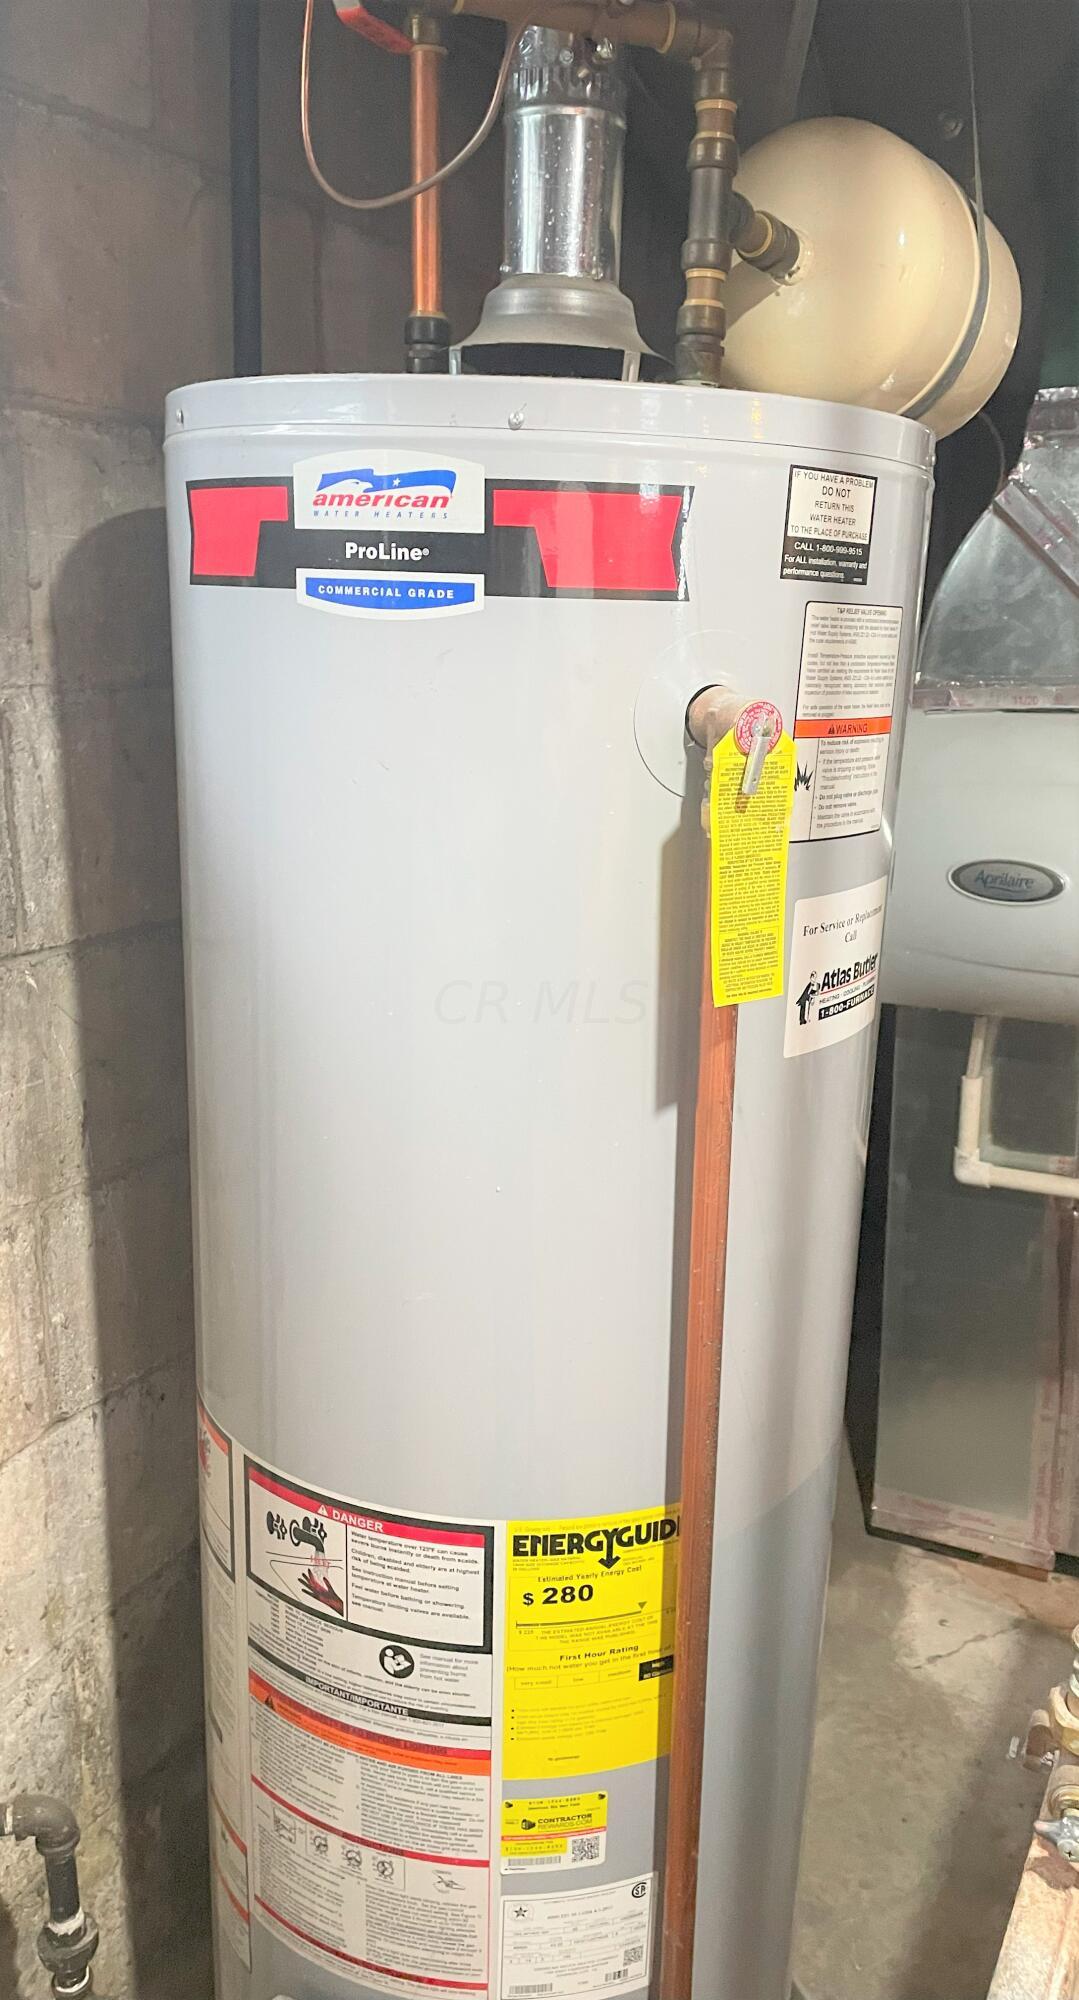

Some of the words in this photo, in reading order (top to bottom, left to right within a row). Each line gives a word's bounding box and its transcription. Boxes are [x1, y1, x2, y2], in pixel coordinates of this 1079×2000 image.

[804, 472, 818, 480] YOU
[820, 474, 839, 483] HAVE
[846, 477, 873, 488] PROBLEM
[822, 486, 833, 495] DO
[836, 488, 851, 498] NOT
[313, 493, 449, 509] american
[815, 501, 840, 510] RETURN
[842, 504, 855, 512] THIS
[374, 511, 448, 519] HEATERS
[810, 513, 832, 523] WATER
[834, 517, 856, 526] HEATER
[791, 525, 799, 533] TO
[801, 526, 812, 535] THE
[814, 527, 832, 537] PLACE
[834, 529, 841, 537] OF
[842, 530, 868, 541] PURCHASE
[794, 541, 814, 551] CALL
[817, 544, 863, 556] 1-800-999-9515
[784, 554, 795, 562] For
[796, 555, 807, 564] ALL
[783, 567, 819, 576] performance
[318, 585, 402, 597] COMMERCIAL
[408, 588, 454, 599] GRADE
[836, 724, 868, 734] WARNING
[975, 870, 1034, 889] Aprilaire
[803, 925, 818, 936] For
[820, 920, 845, 933] Service
[847, 918, 853, 926] or
[845, 930, 857, 942] Call
[821, 968, 851, 991] Atlas
[853, 953, 878, 980] Butler
[332, 1509, 384, 1533] DANGER
[351, 1531, 367, 1540] Water
[368, 1536, 402, 1548] temperature
[351, 1538, 369, 1547] severe
[370, 1542, 387, 1551] burns
[370, 1559, 386, 1569] being
[377, 1555, 402, 1565] disabled
[416, 1562, 436, 1571] elderly
[456, 1567, 480, 1576] highest
[351, 1573, 384, 1586] temperature
[363, 1569, 393, 1580] instruction
[394, 1576, 416, 1585] manual
[417, 1580, 437, 1588] before
[438, 1583, 460, 1591] setting
[538, 1575, 573, 1583] Estimated
[576, 1572, 598, 1581] Yearly
[601, 1569, 625, 1577] Energy
[627, 1565, 642, 1573] Cost
[351, 1593, 386, 1606] Temperature
[380, 1590, 399, 1599] before
[400, 1594, 423, 1604] bathing
[523, 1593, 534, 1606] $
[542, 1584, 594, 1605] 280
[559, 1654, 581, 1662] First
[609, 1645, 639, 1655] Rating
[305, 1676, 409, 1716] IMPORTANT/IMPORTANTE
[538, 1813, 592, 1824] CONTRACTOR
[538, 1819, 592, 1829] REWARDS.COM
